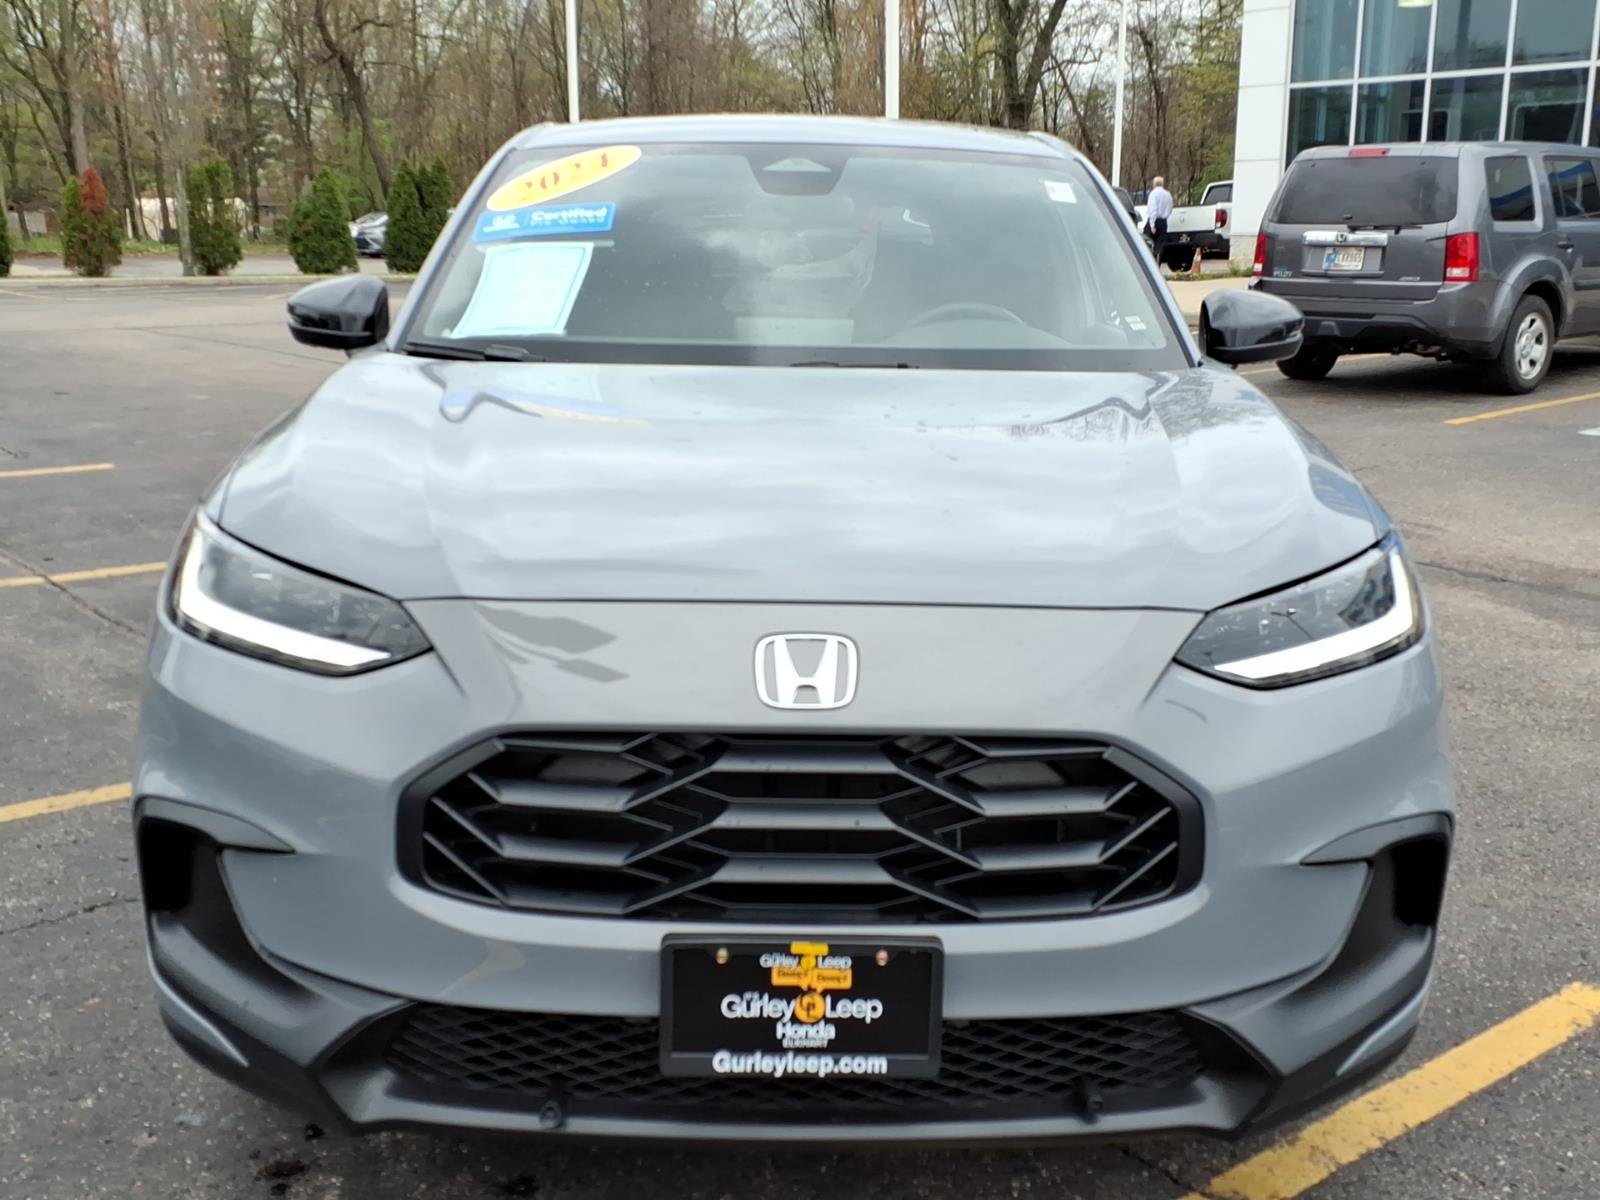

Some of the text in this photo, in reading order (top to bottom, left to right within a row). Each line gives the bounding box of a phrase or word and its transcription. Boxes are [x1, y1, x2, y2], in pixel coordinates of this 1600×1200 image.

[817, 955, 852, 969] Leep
[825, 993, 884, 1024] Leep
[776, 1021, 836, 1041] Honda
[711, 1050, 888, 1077] Gurleyleep.com
